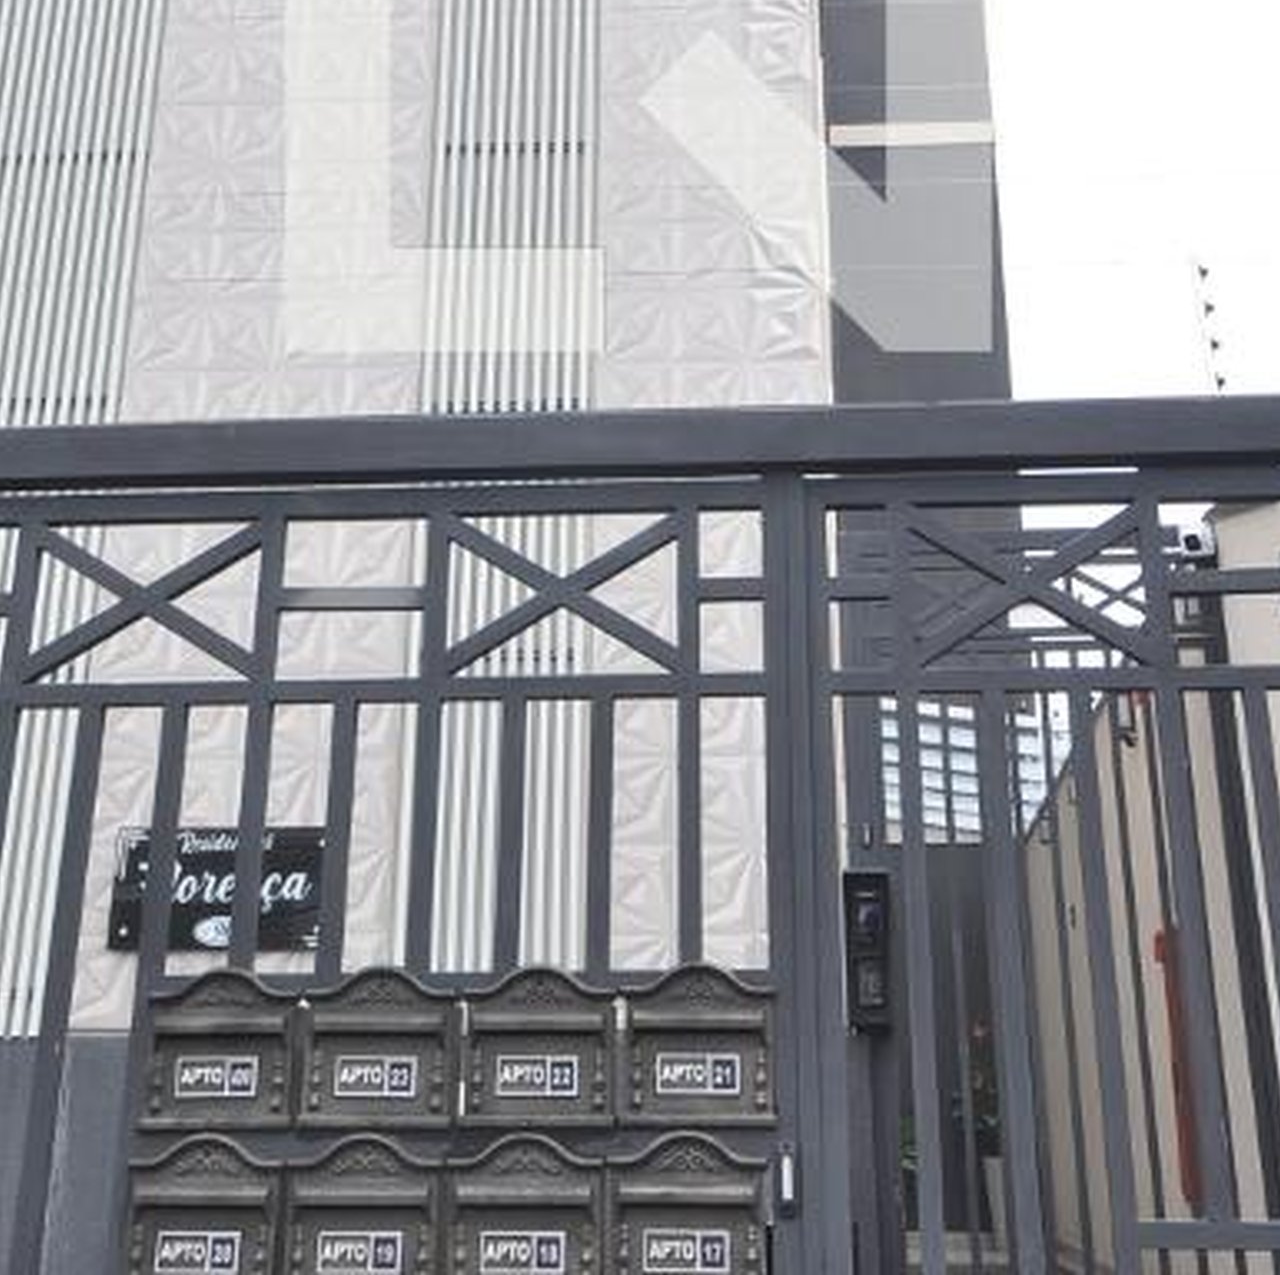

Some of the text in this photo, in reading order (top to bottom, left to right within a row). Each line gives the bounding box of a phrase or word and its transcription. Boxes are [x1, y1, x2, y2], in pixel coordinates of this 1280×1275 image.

[180, 1065, 224, 1085] APTO
[340, 1065, 382, 1084] APTO
[500, 1064, 545, 1084] APTO
[661, 1062, 705, 1081] APTO
[160, 1242, 206, 1262] APTO
[323, 1242, 368, 1262] APTO
[484, 1241, 531, 1262] APTO
[649, 1240, 694, 1260] APTO
